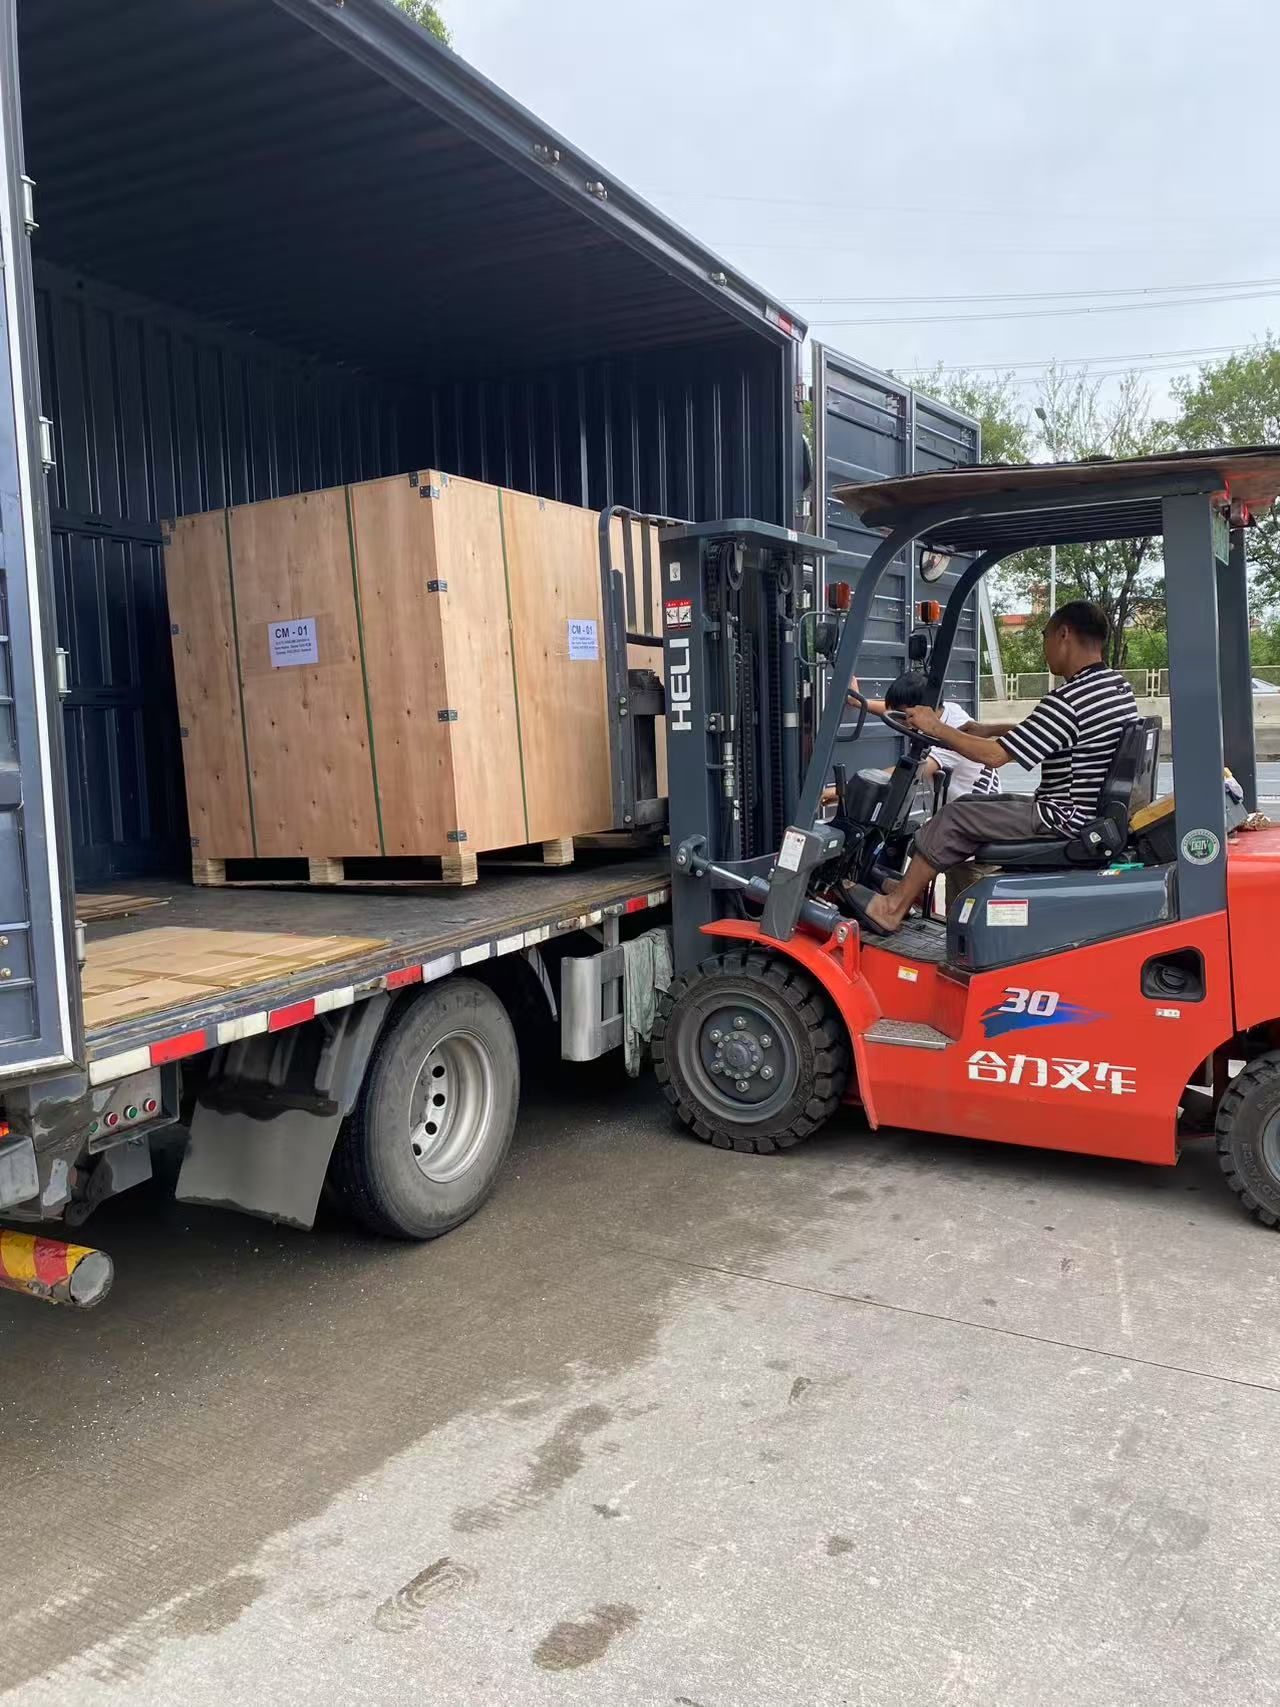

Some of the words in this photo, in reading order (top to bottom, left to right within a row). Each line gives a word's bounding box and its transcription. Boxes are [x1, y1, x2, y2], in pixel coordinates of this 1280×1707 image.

[275, 627, 289, 638] CM
[298, 625, 307, 636] 01
[571, 625, 581, 635] CM
[586, 625, 592, 635] 01
[669, 638, 692, 730] HELI
[998, 987, 1060, 1017] 30
[964, 1050, 1136, 1095] 合力叉车
